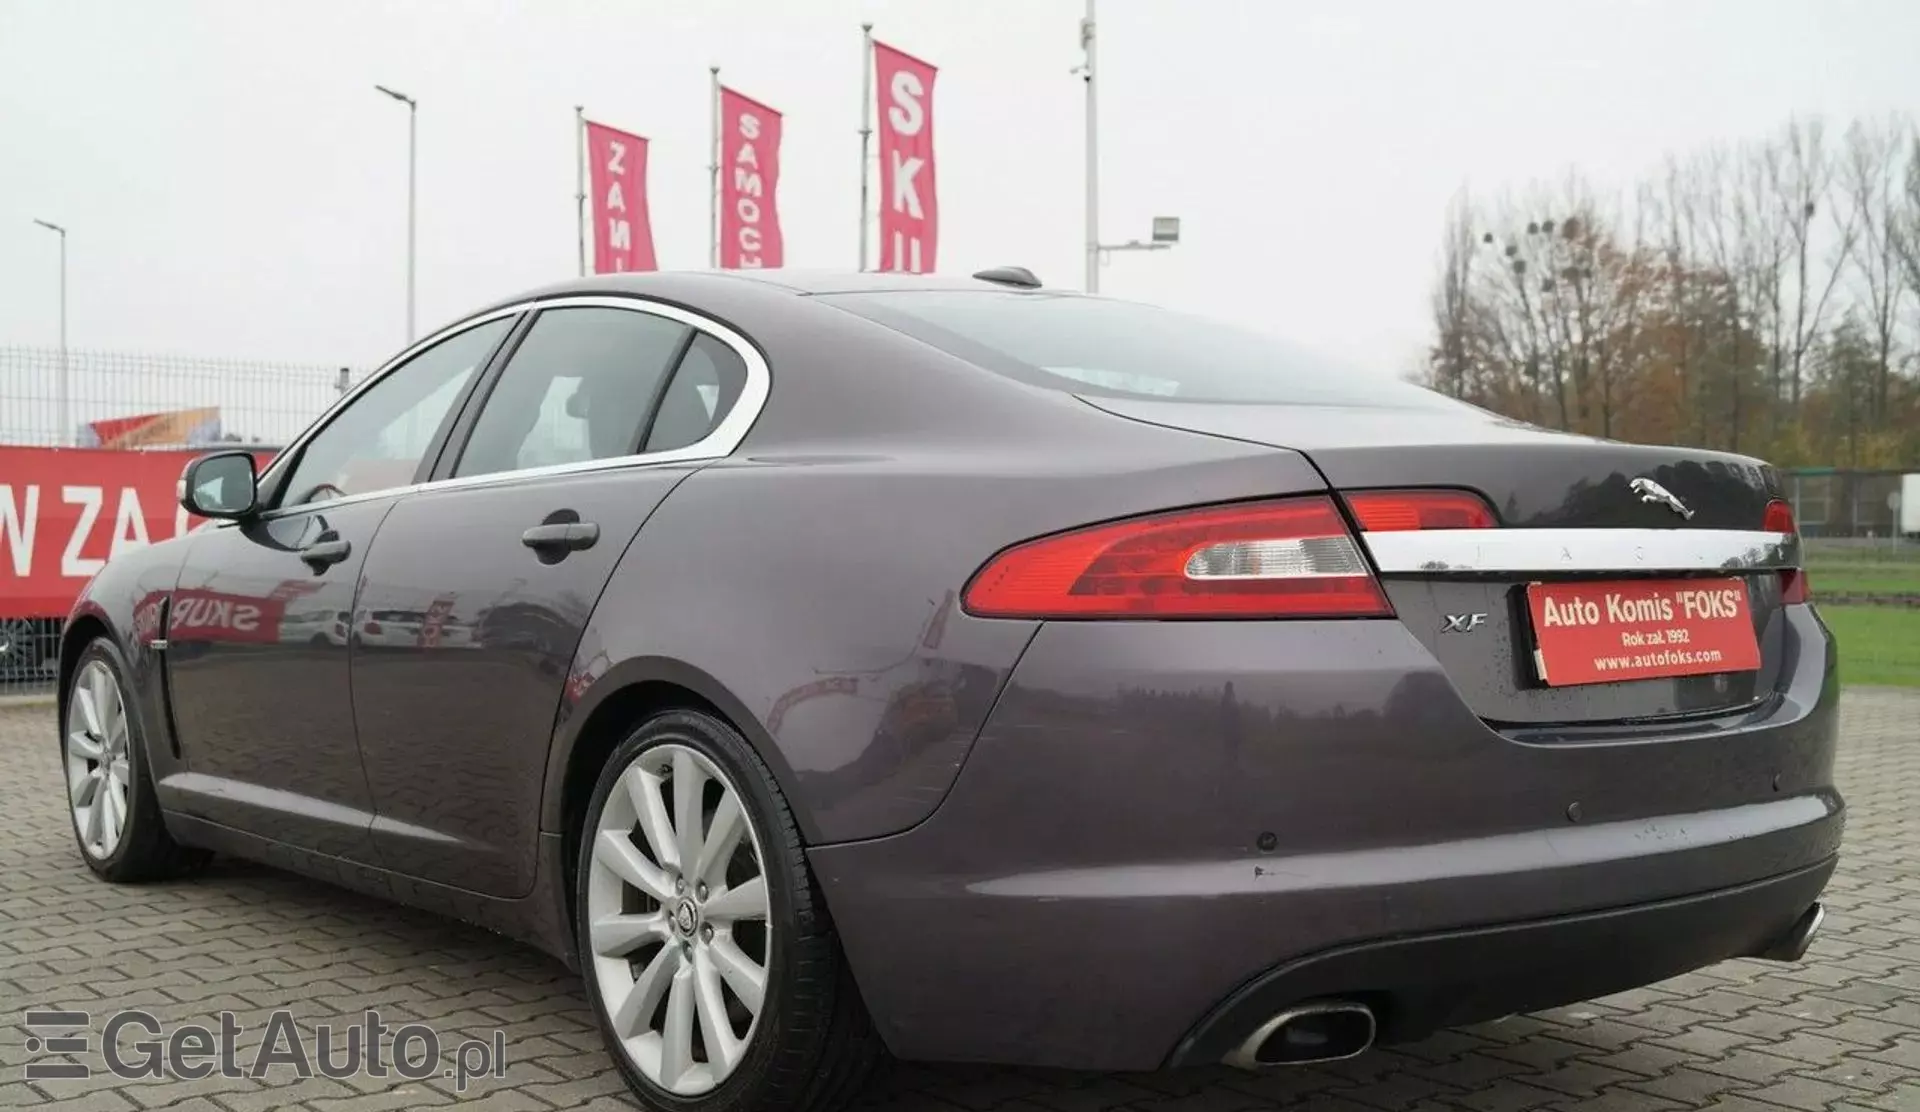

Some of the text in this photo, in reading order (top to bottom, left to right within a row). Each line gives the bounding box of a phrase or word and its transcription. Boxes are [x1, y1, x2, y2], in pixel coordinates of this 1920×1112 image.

[1543, 596, 1600, 627] Auto
[1605, 592, 1674, 624] Komis
[1441, 613, 1489, 632] XF
[1622, 631, 1645, 647] Rok
[1665, 628, 1690, 644] 1992
[1594, 649, 1722, 671] www.autofoks.com
